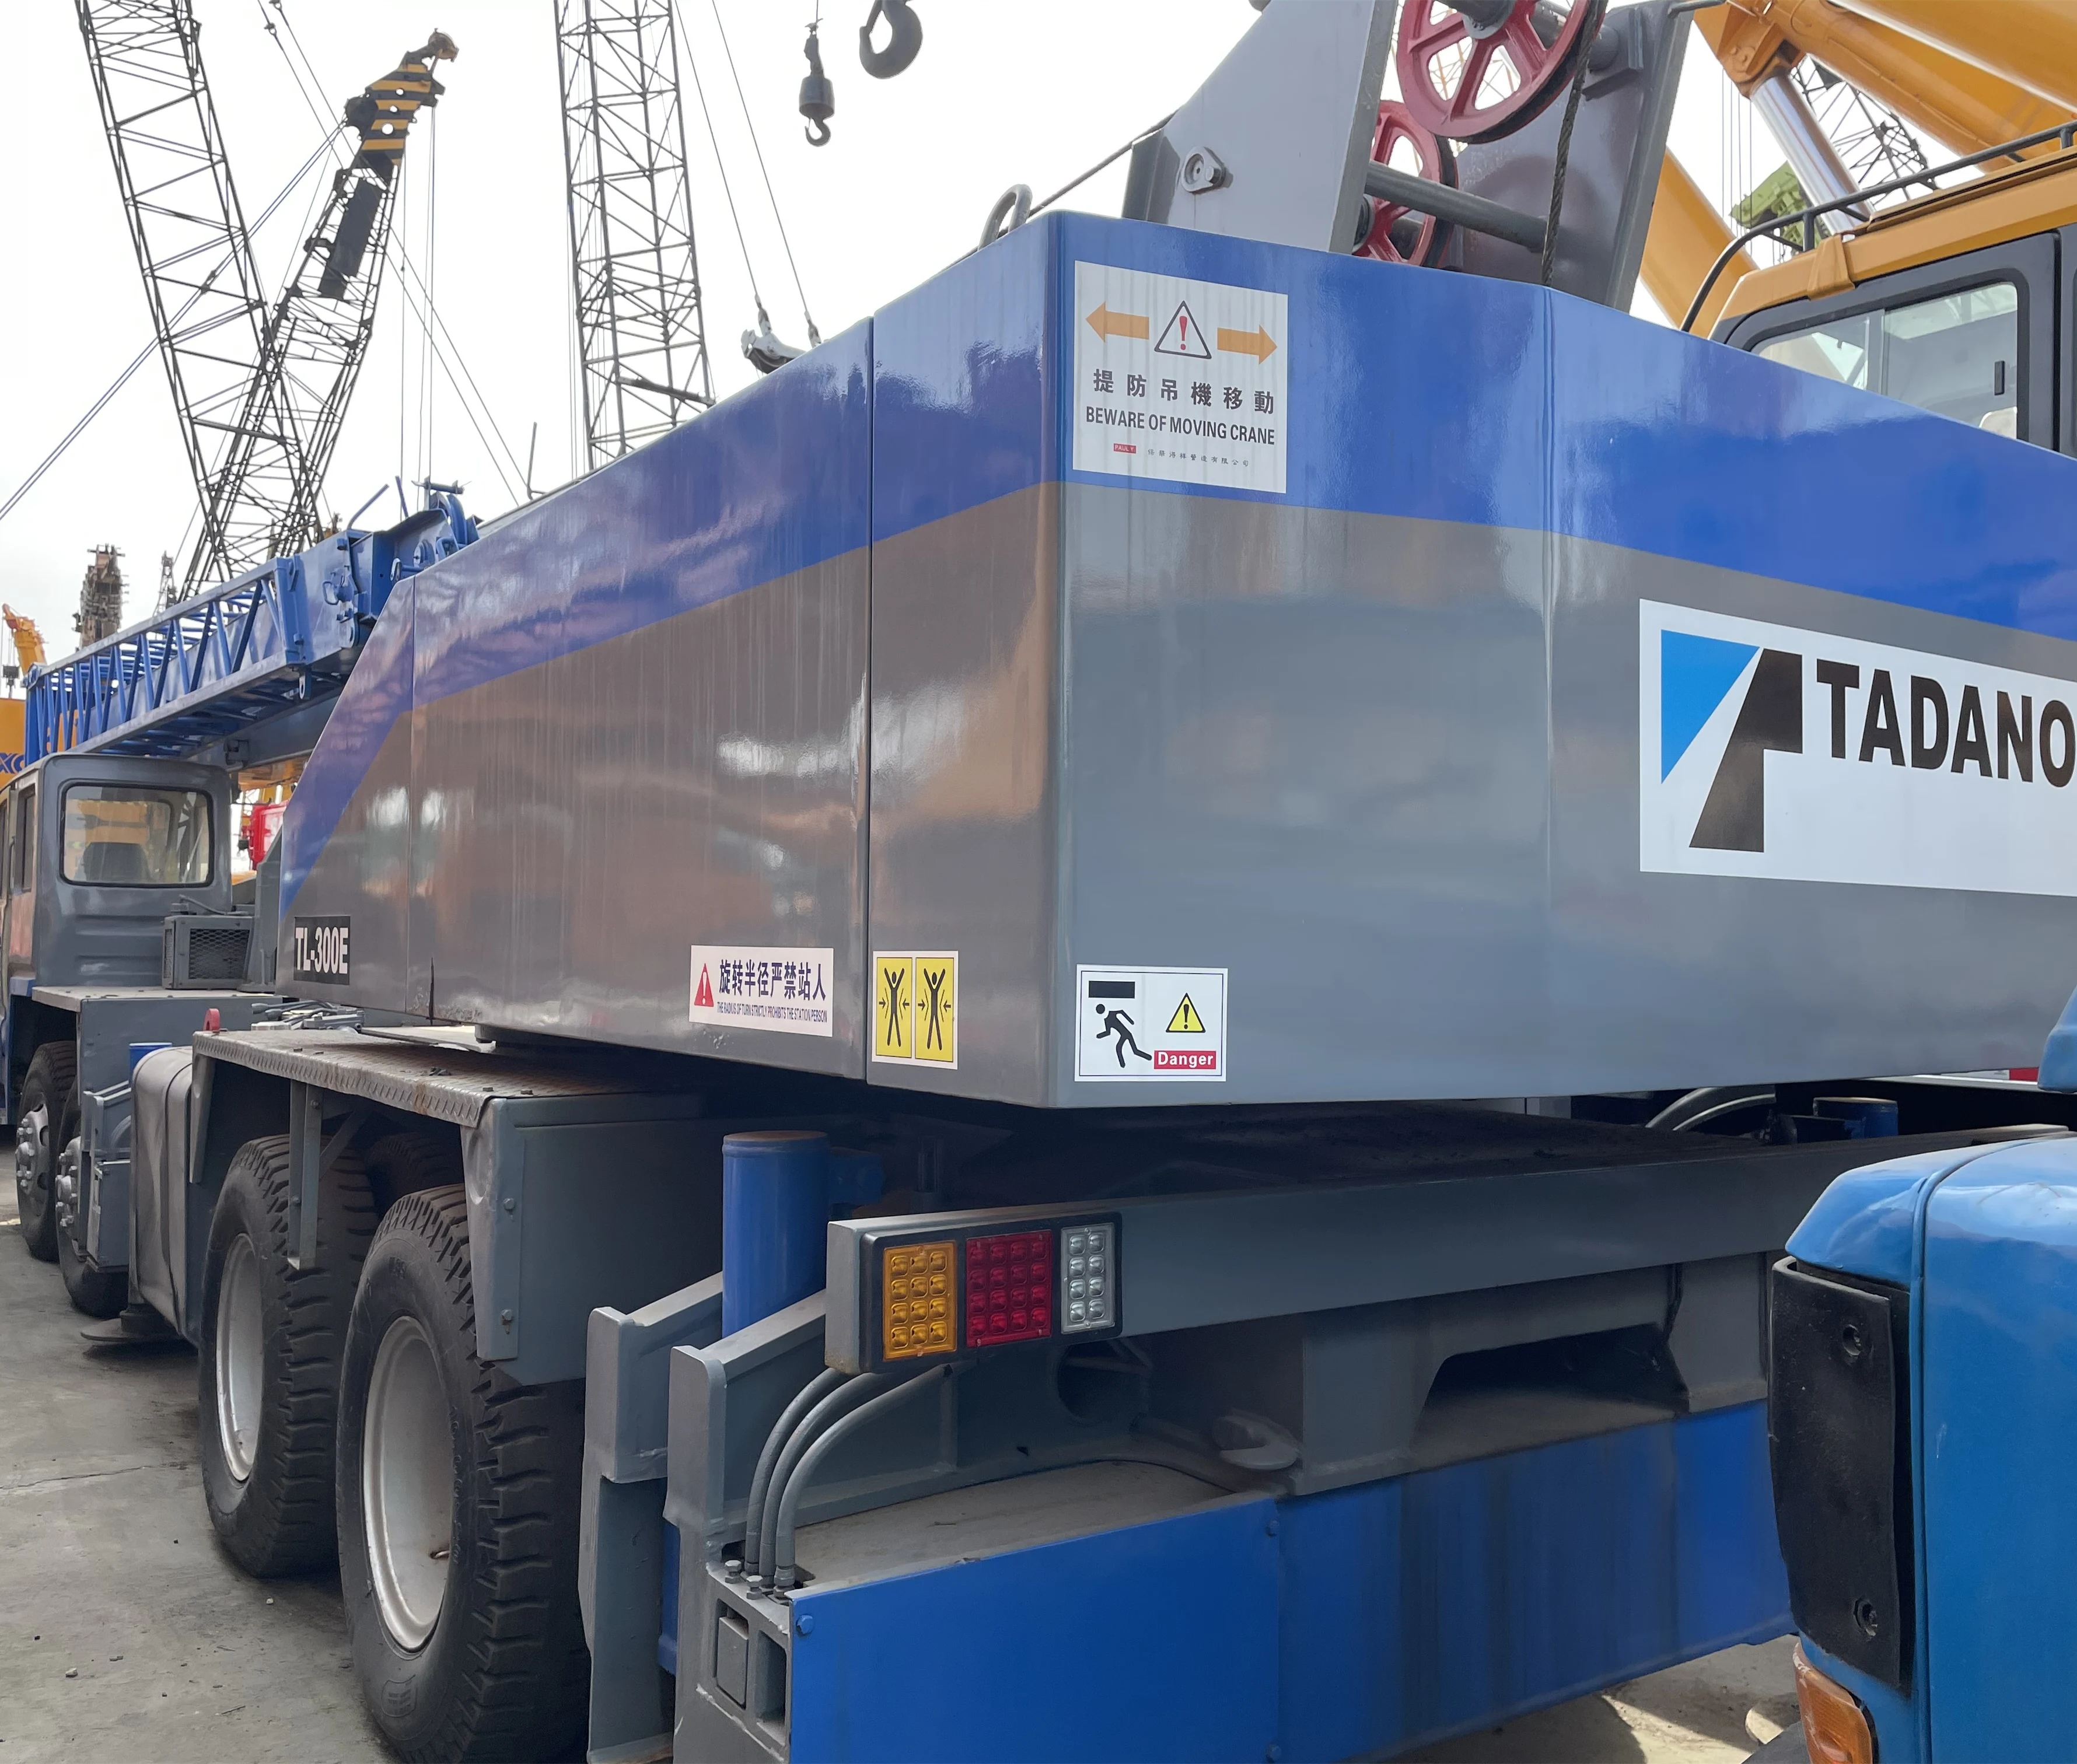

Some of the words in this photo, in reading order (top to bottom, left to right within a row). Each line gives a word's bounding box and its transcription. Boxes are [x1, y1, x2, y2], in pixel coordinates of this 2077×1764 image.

[1093, 368, 1274, 415] 提防吊機移動
[1086, 406, 1145, 429] BEWARE
[1149, 414, 1167, 432] OF
[1170, 416, 1226, 439] MOVING
[1230, 424, 1275, 445] CRANE
[1816, 658, 2076, 788] TADANO
[295, 926, 349, 974] TL-300E
[719, 959, 826, 1002] 旋转半径严禁站人
[723, 1002, 736, 1014] RADIUS
[736, 1003, 742, 1015] OF
[742, 1003, 751, 1016] TURN
[751, 1005, 767, 1018] STRICTLY
[767, 1006, 786, 1019] PROHIBITS
[794, 1007, 811, 1021] STATION
[811, 1009, 827, 1023] PERSON
[1158, 1051, 1214, 1068] Danger
